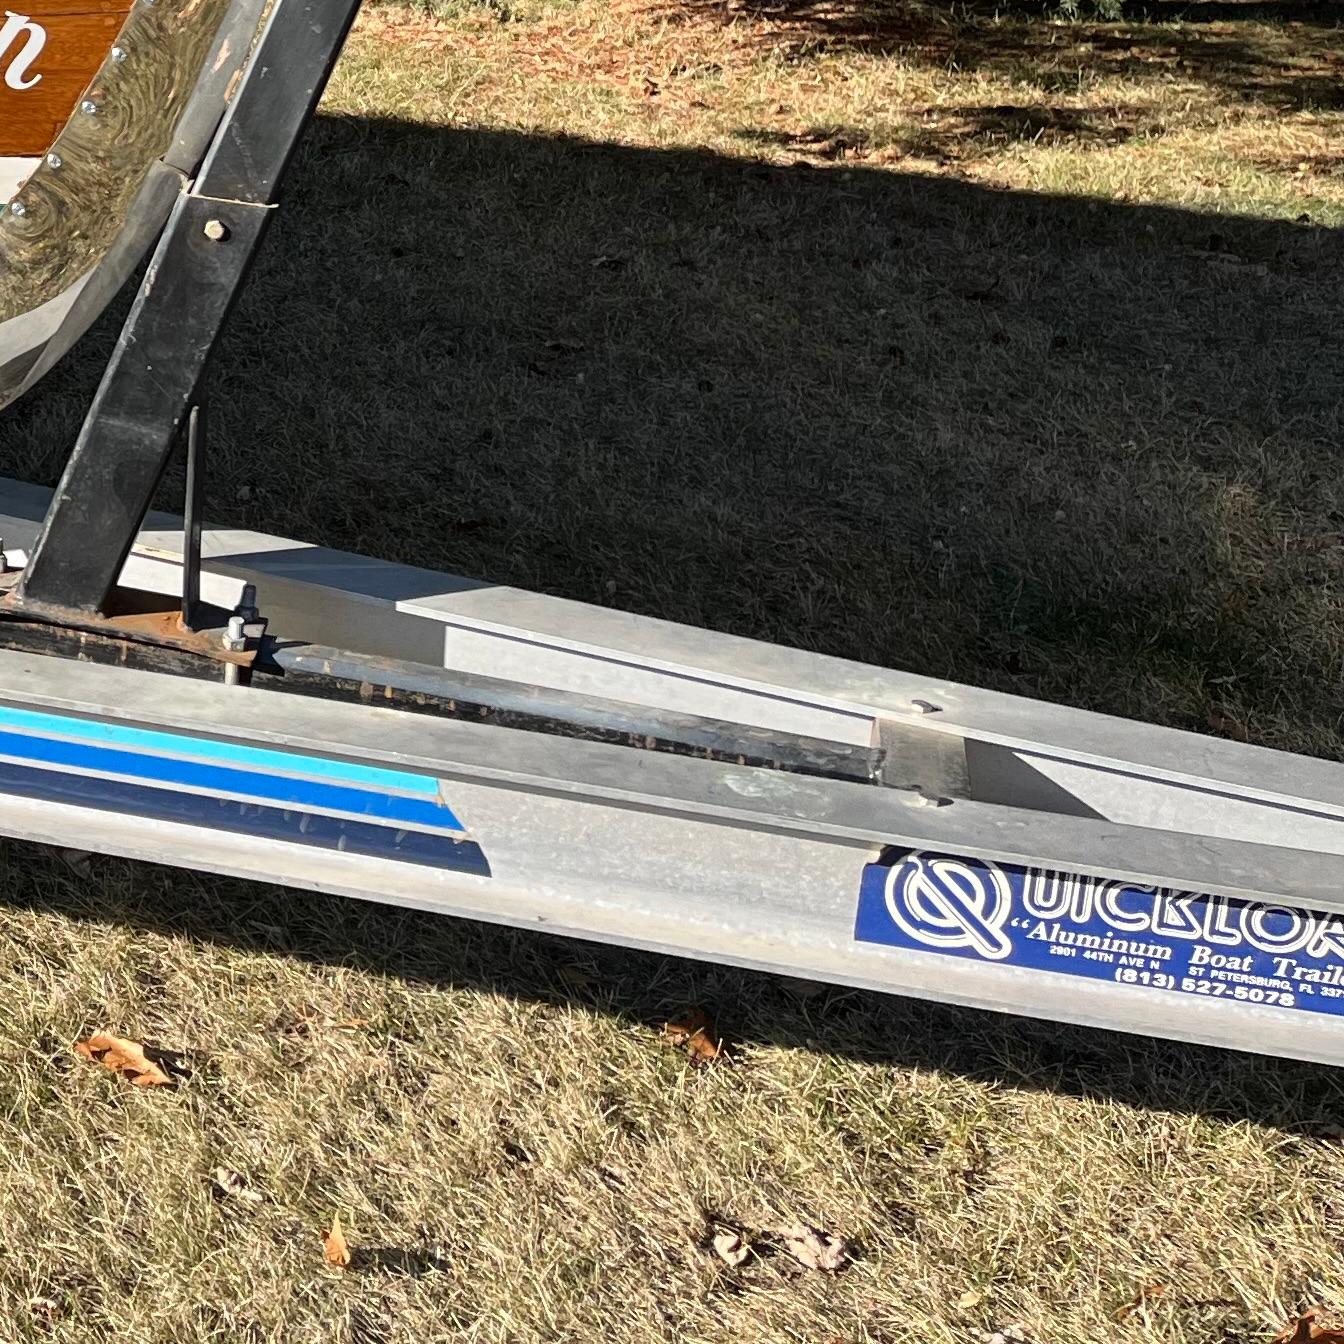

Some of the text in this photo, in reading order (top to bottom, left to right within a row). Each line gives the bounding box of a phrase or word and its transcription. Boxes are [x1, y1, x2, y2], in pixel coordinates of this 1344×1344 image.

[1082, 950, 1114, 964] 44TH
[1119, 956, 1144, 967] AVE
[1150, 960, 1160, 970] N
[1188, 966, 1205, 976] ST
[1298, 983, 1315, 994] FL
[1320, 986, 1344, 998] 337
[1188, 944, 1254, 972] Boat
[1271, 957, 1344, 986] Trail
[1115, 968, 1295, 1007] (813) 527-5078
